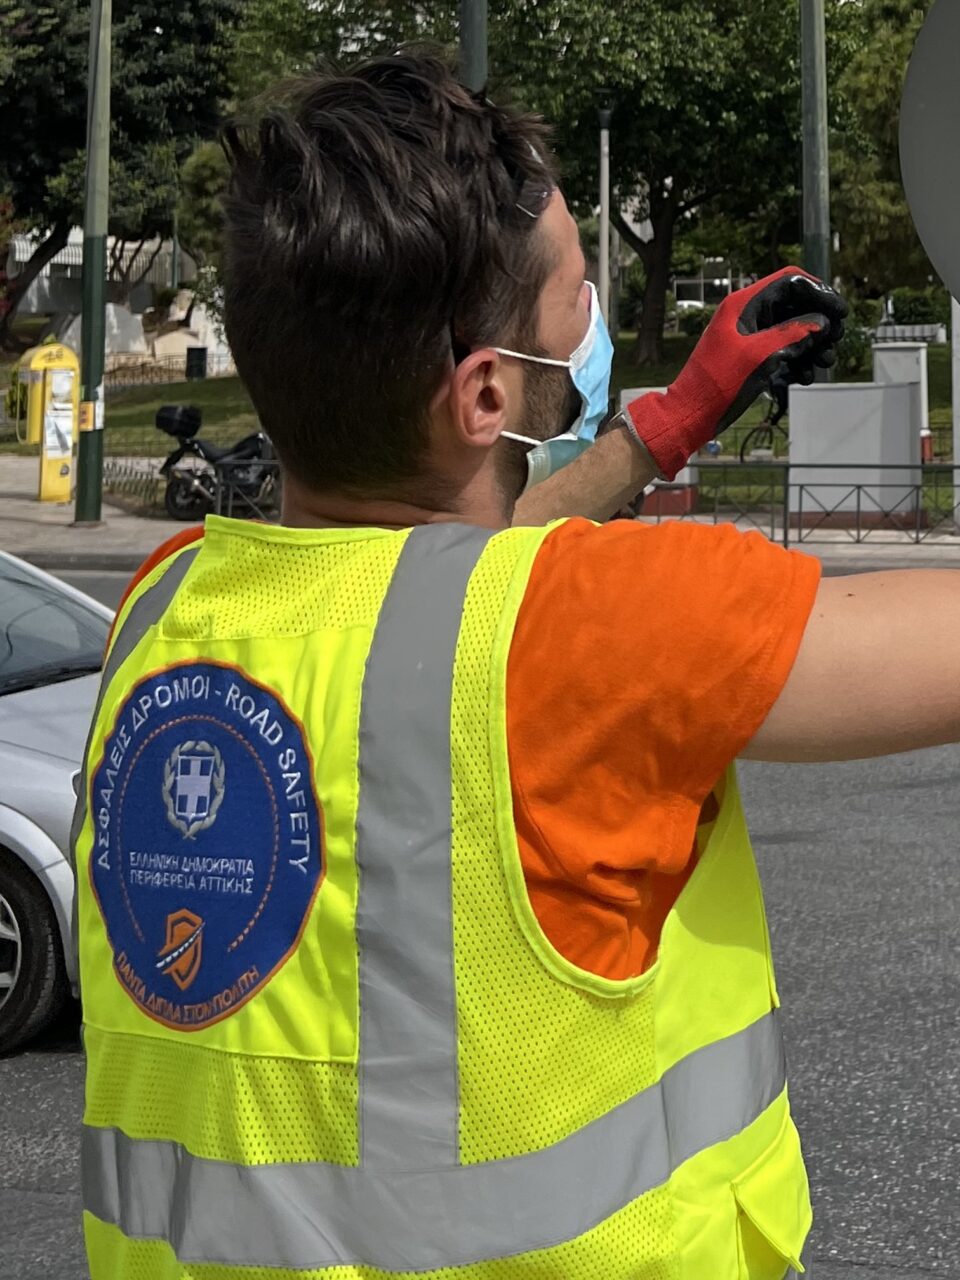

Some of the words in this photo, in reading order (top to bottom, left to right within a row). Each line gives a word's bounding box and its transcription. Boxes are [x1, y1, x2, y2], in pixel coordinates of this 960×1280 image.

[97, 724, 132, 870] ΑΣΦΑΛΕΙΣ
[131, 675, 210, 732] ΔΡΟΜΟΙ
[224, 682, 283, 747] ROAD
[278, 747, 312, 875] SAFETY
[129, 851, 179, 870] ΕΛΛΗΝΙΚΗ
[181, 856, 255, 876] ΔΗΜΟΚΡΑΤΙΑ
[130, 869, 196, 889] ΠΕΡΙΦΕΡΕΙΑ
[199, 875, 254, 894] ΑΤΤΙΚΗΣ
